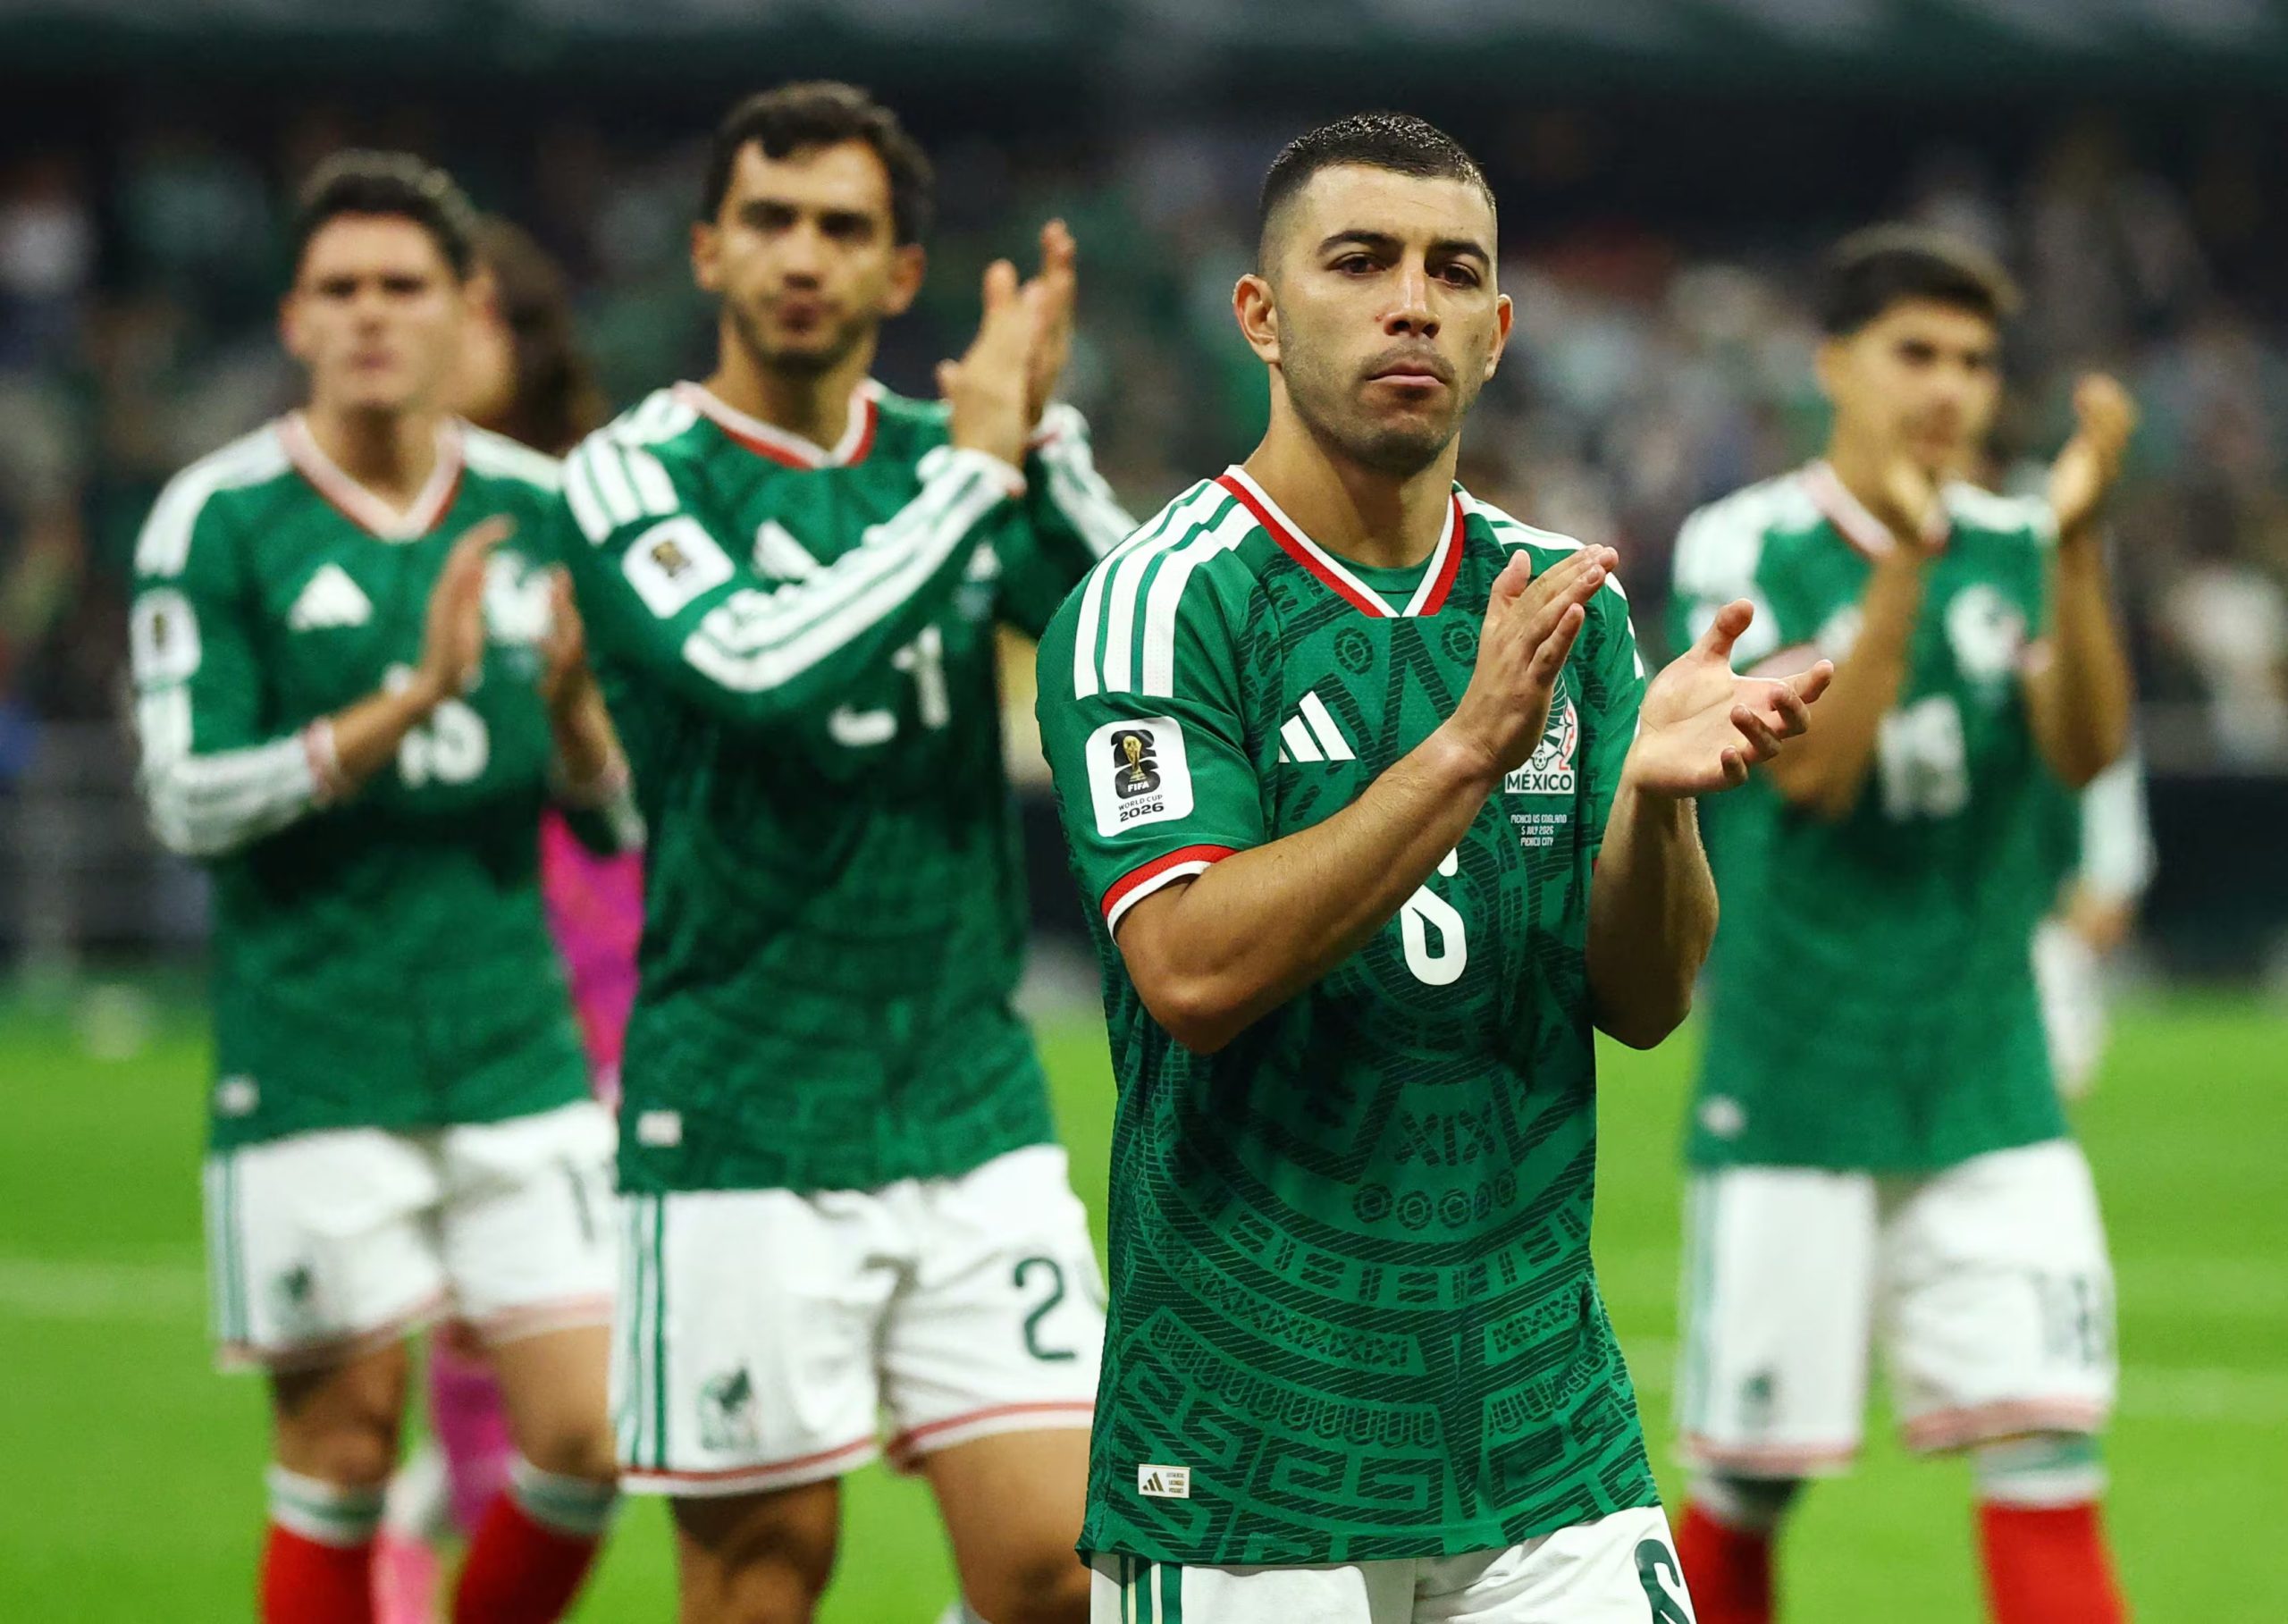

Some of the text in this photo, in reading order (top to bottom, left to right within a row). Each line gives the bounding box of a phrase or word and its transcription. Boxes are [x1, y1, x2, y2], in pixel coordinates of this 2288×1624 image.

[1127, 780, 1150, 793] FIFA
[1507, 770, 1573, 791] MÉXICO
[1118, 794, 1164, 812] WORLD CUP
[1119, 803, 1165, 822] 2026
[1400, 846, 1468, 986] 6
[1014, 1255, 1076, 1360] 2
